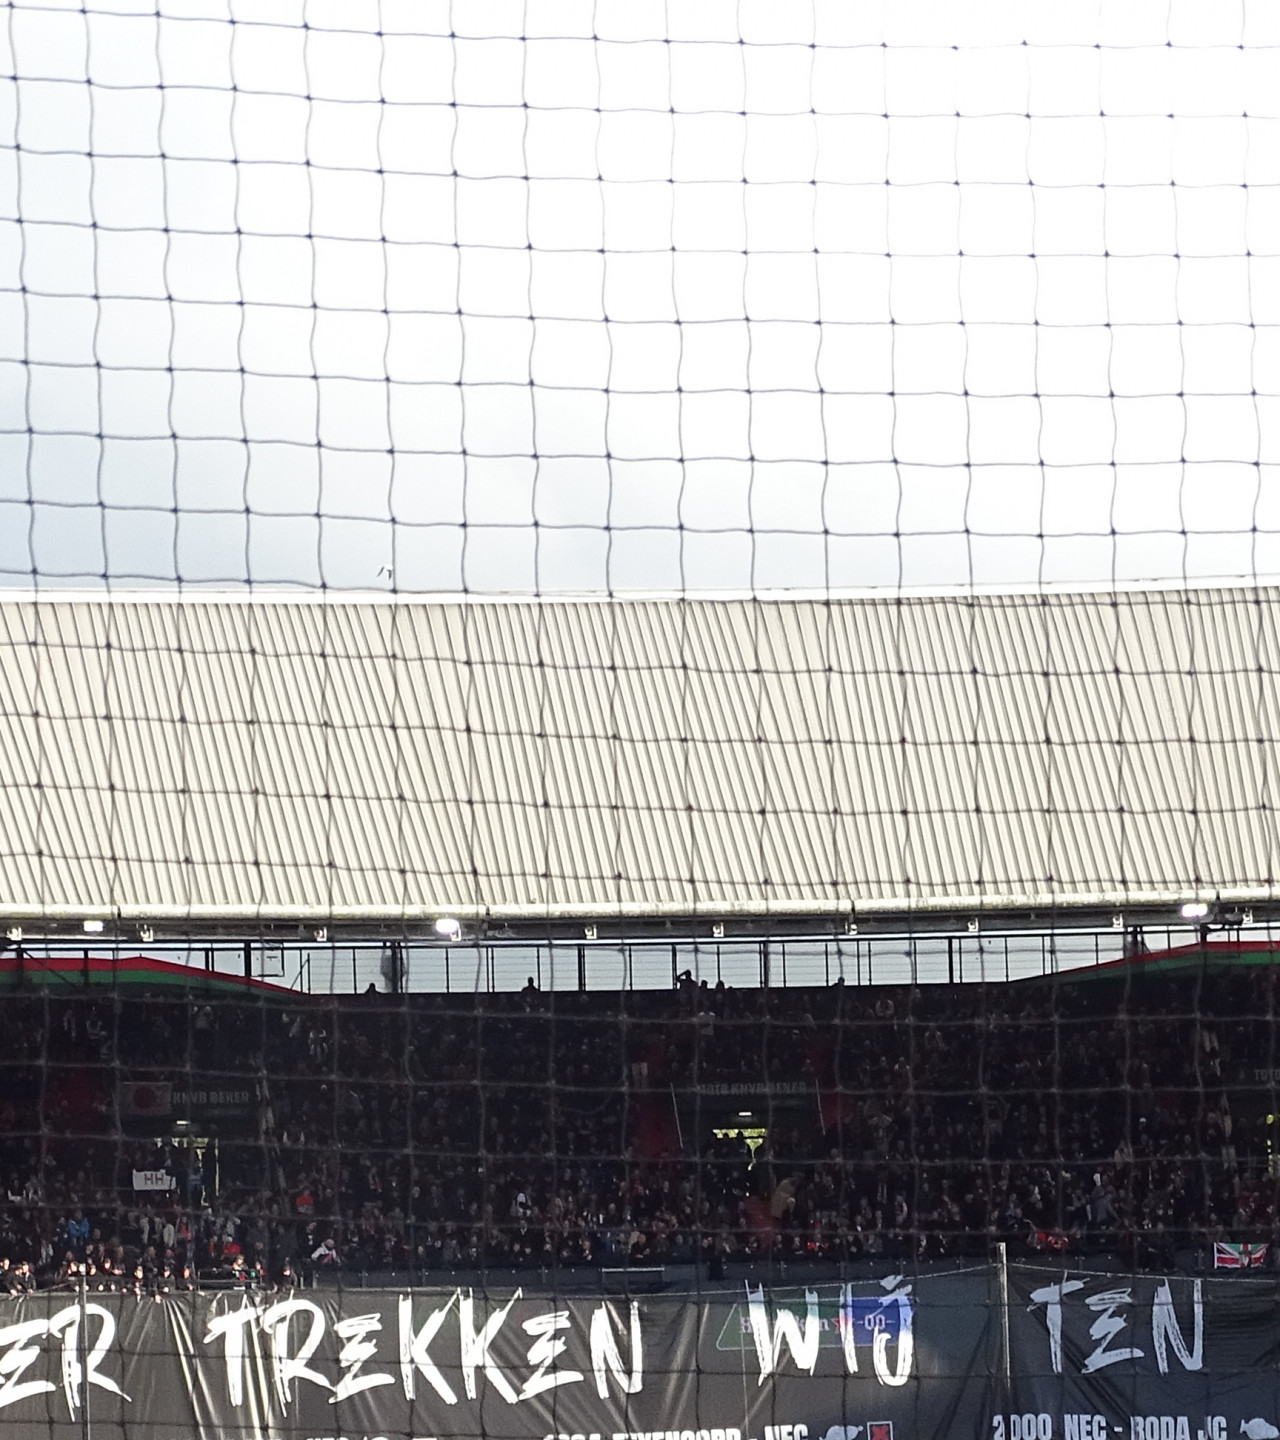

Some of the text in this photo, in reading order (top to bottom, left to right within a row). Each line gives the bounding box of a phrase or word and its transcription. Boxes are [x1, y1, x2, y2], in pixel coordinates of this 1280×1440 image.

[203, 1288, 643, 1416] TREKKEN
[744, 1275, 914, 1387] WIJ
[1026, 1270, 1204, 1375] TEN
